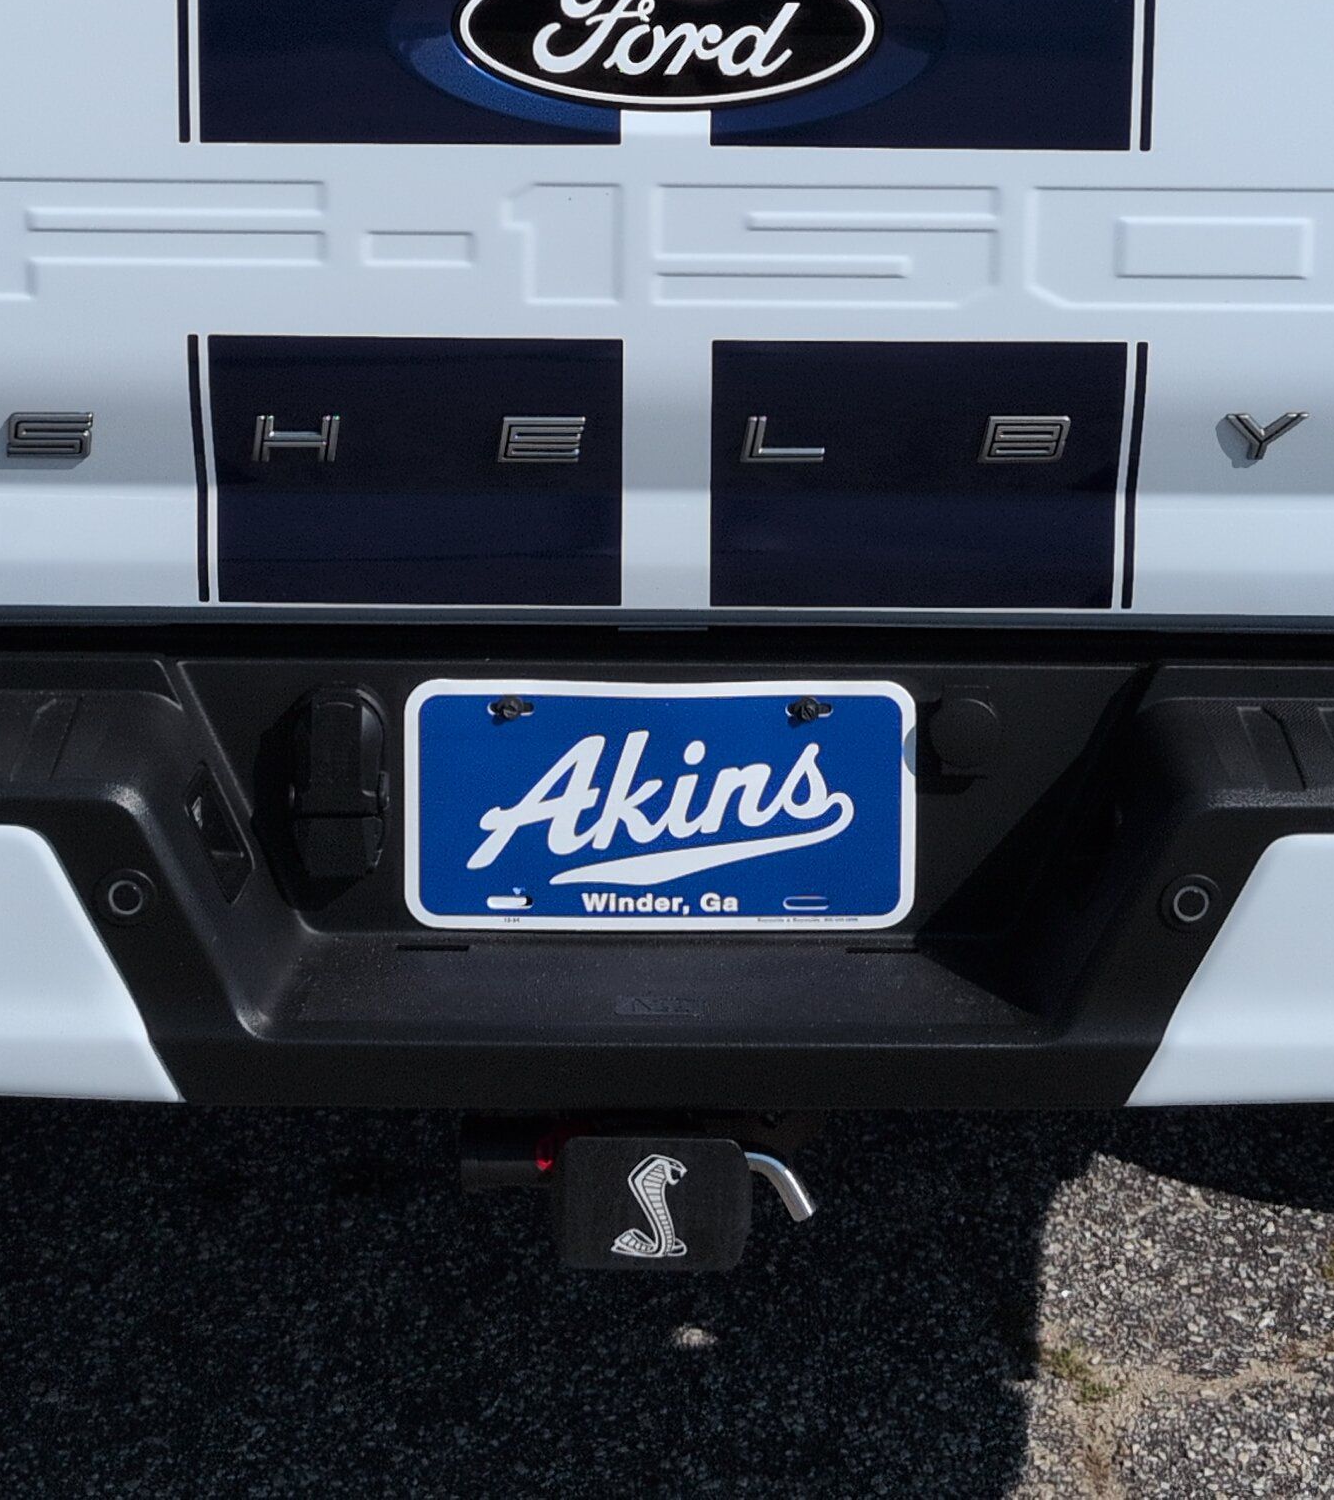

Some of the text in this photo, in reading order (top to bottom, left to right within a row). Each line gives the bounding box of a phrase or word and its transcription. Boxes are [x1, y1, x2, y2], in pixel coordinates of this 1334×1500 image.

[4, 408, 1311, 467] SHELBY
[466, 729, 855, 885] Akins
[581, 891, 739, 915] Winder, Ga
